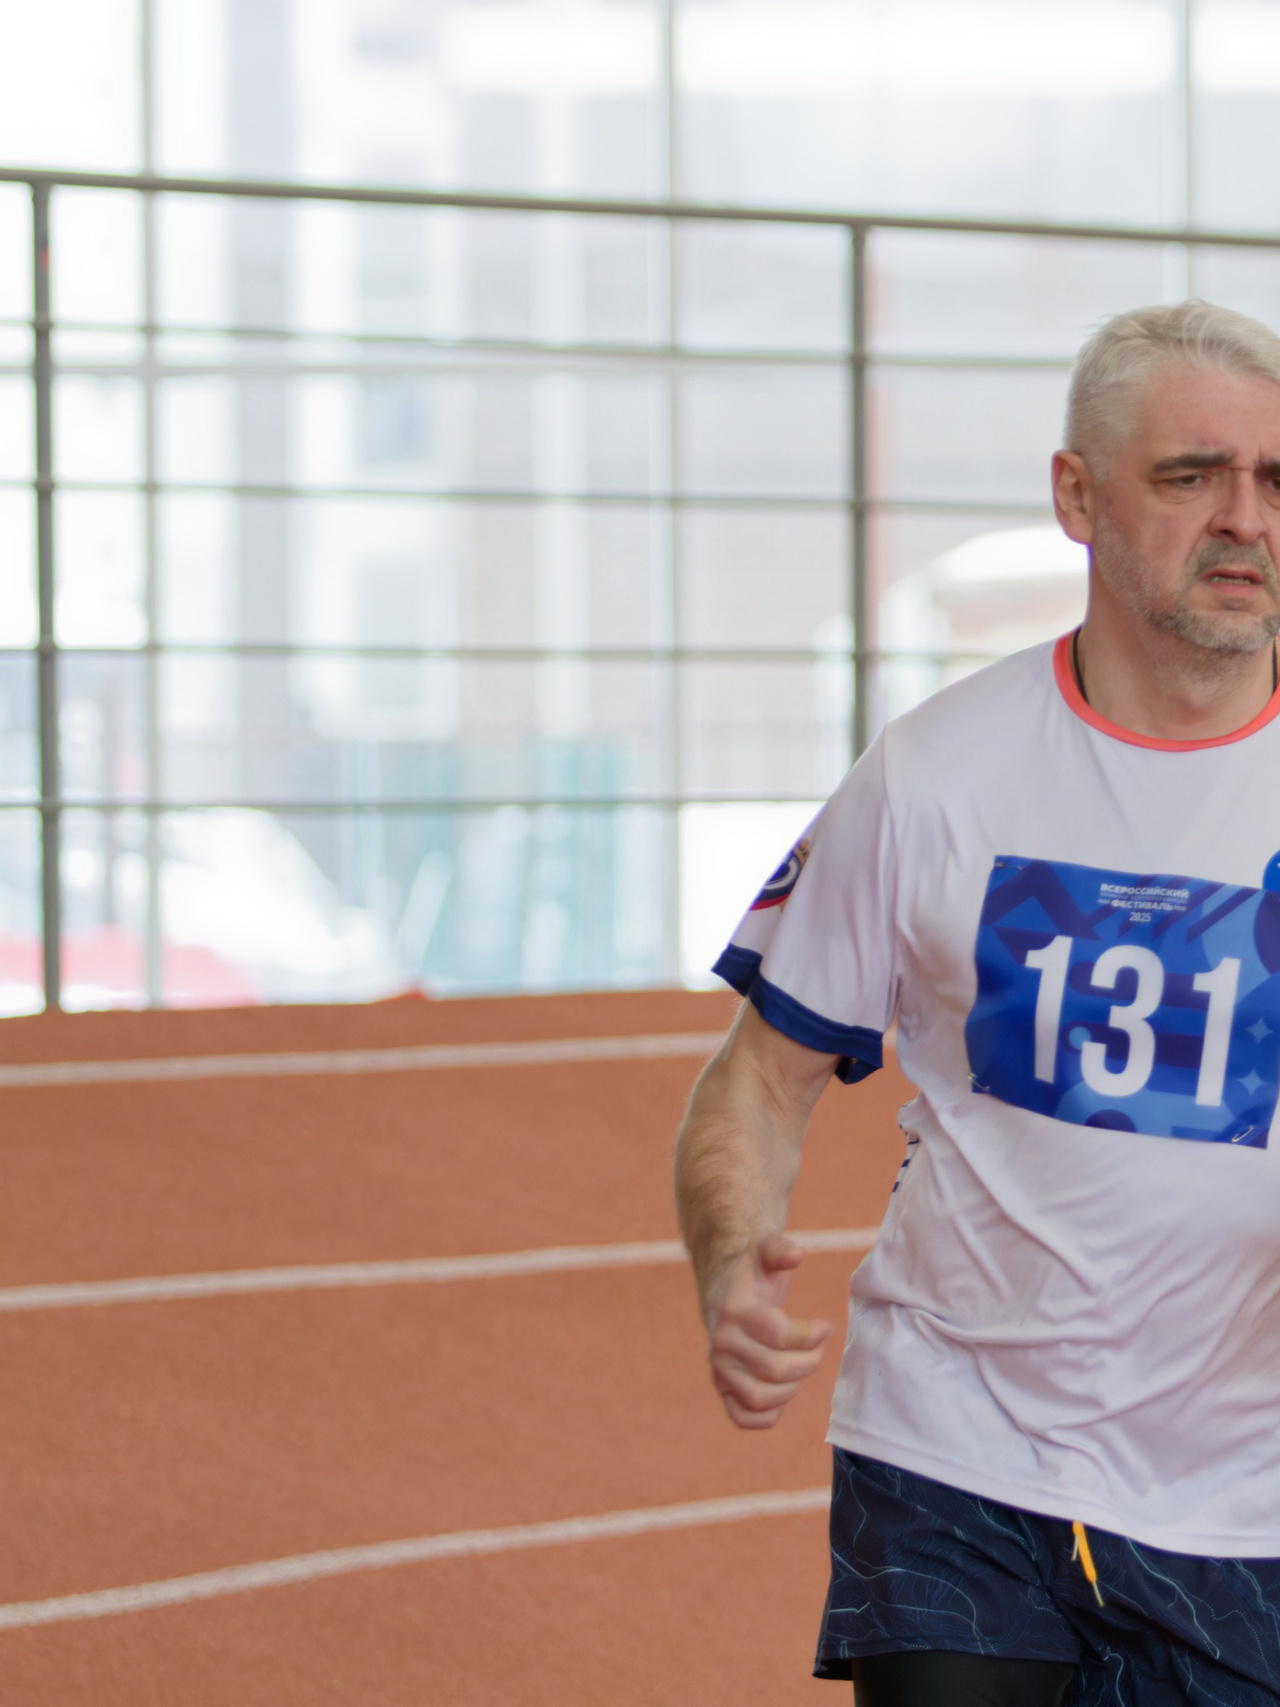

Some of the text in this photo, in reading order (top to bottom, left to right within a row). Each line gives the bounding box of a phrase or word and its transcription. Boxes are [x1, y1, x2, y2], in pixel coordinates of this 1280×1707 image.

[1100, 883, 1189, 899] ВСЕРОССИЙСКИЙ
[1111, 899, 1173, 911] ФЕСТИВАЛЬ
[1129, 911, 1152, 922] 2025
[1024, 935, 1241, 1106] 131
